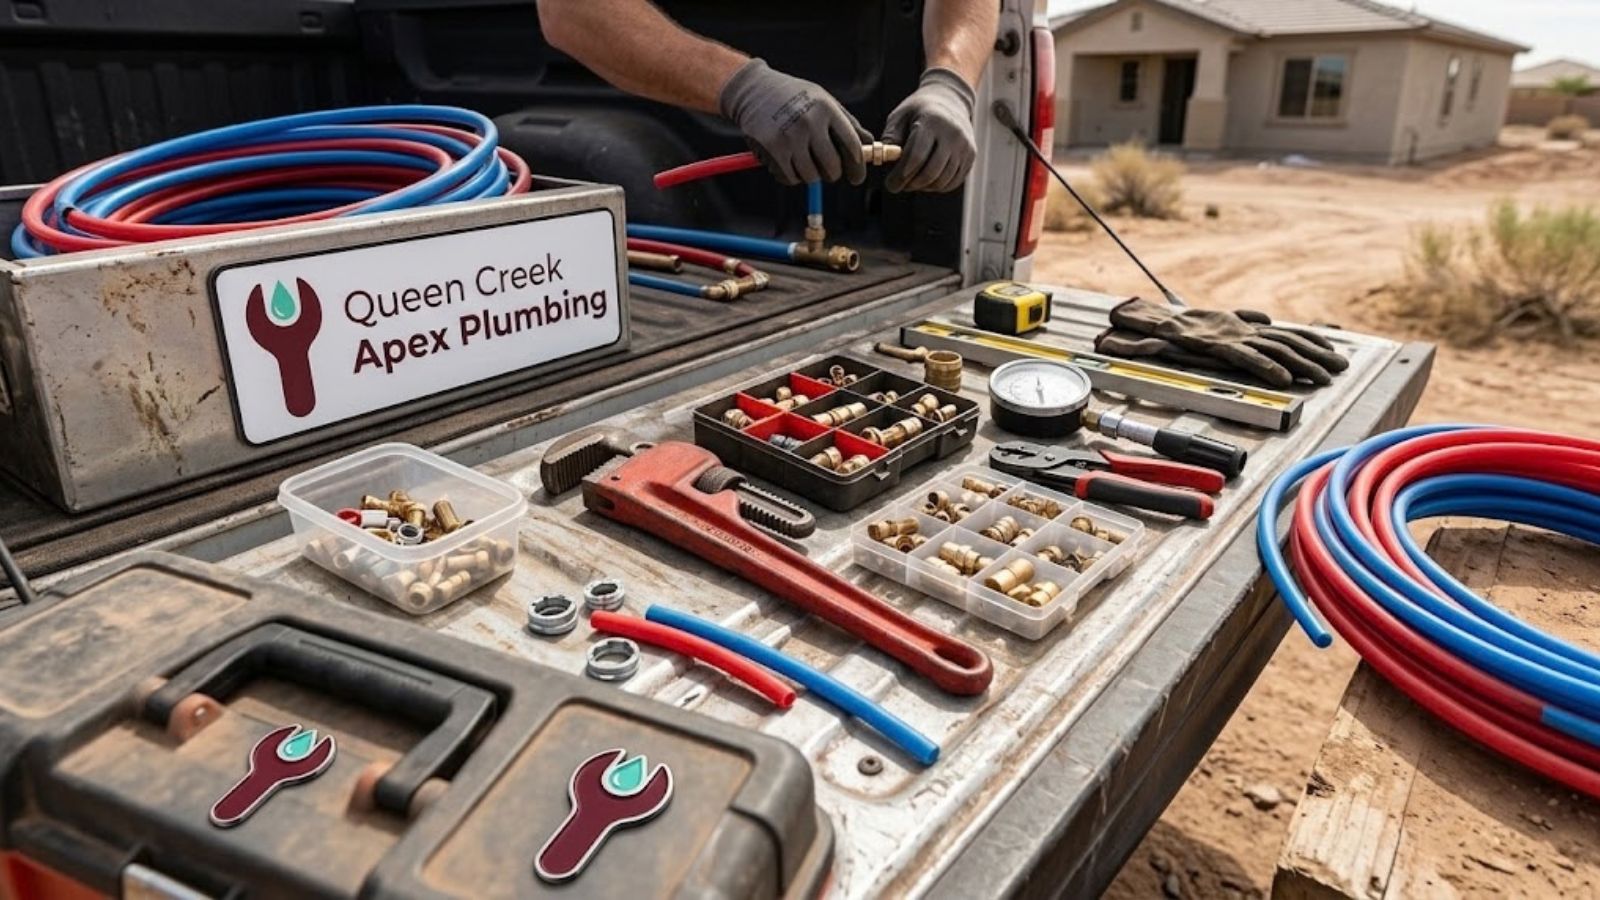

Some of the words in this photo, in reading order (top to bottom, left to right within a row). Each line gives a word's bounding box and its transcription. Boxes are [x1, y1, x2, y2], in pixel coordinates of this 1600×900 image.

[344, 280, 465, 328] Queen
[475, 252, 564, 297] Creek
[352, 327, 451, 375] Apex
[459, 288, 608, 347] Plumbing
